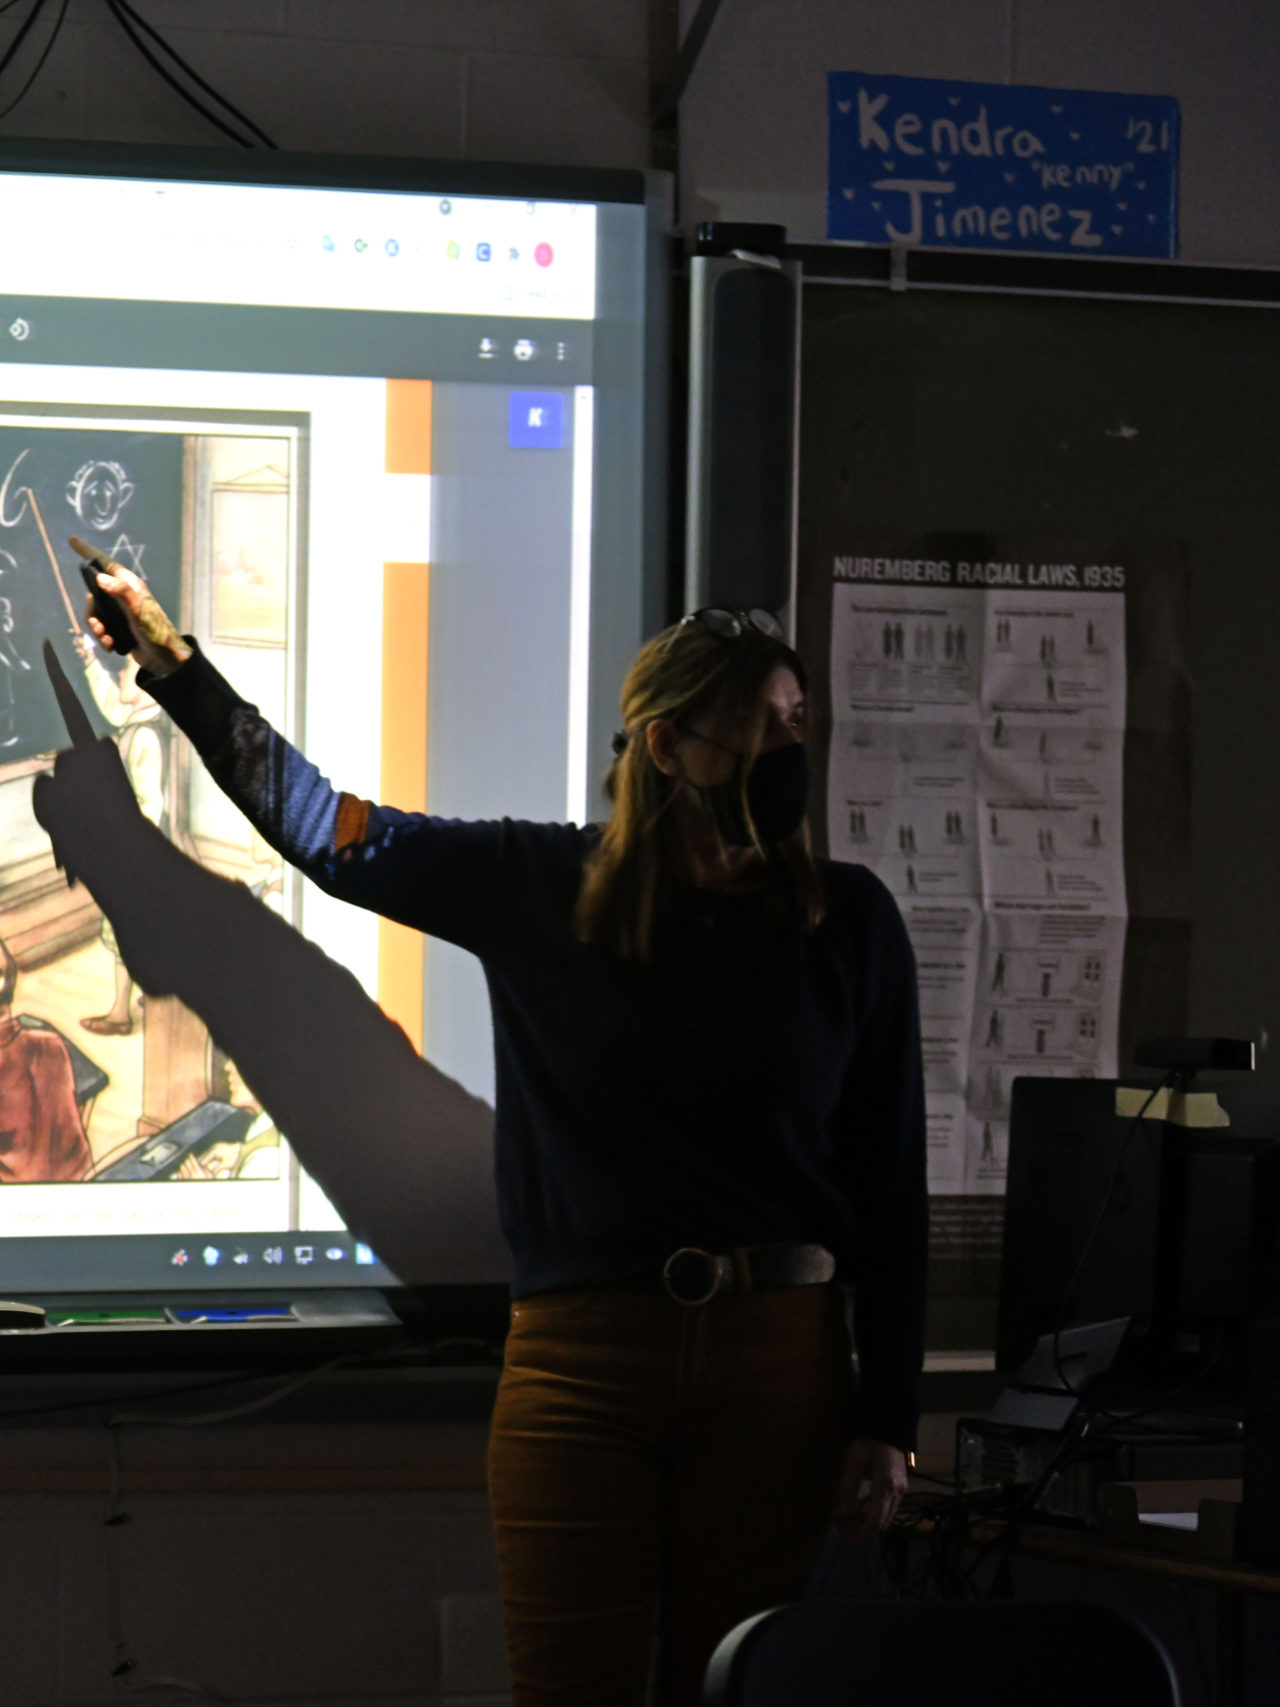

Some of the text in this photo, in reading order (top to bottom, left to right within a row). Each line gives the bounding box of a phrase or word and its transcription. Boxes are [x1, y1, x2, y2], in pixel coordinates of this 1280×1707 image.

[858, 86, 1046, 159] Kendra
[872, 179, 1104, 248] Jimenez
[527, 407, 543, 427] K
[833, 555, 1126, 589] NUREMBERG RACIAL LAWS, 1935
